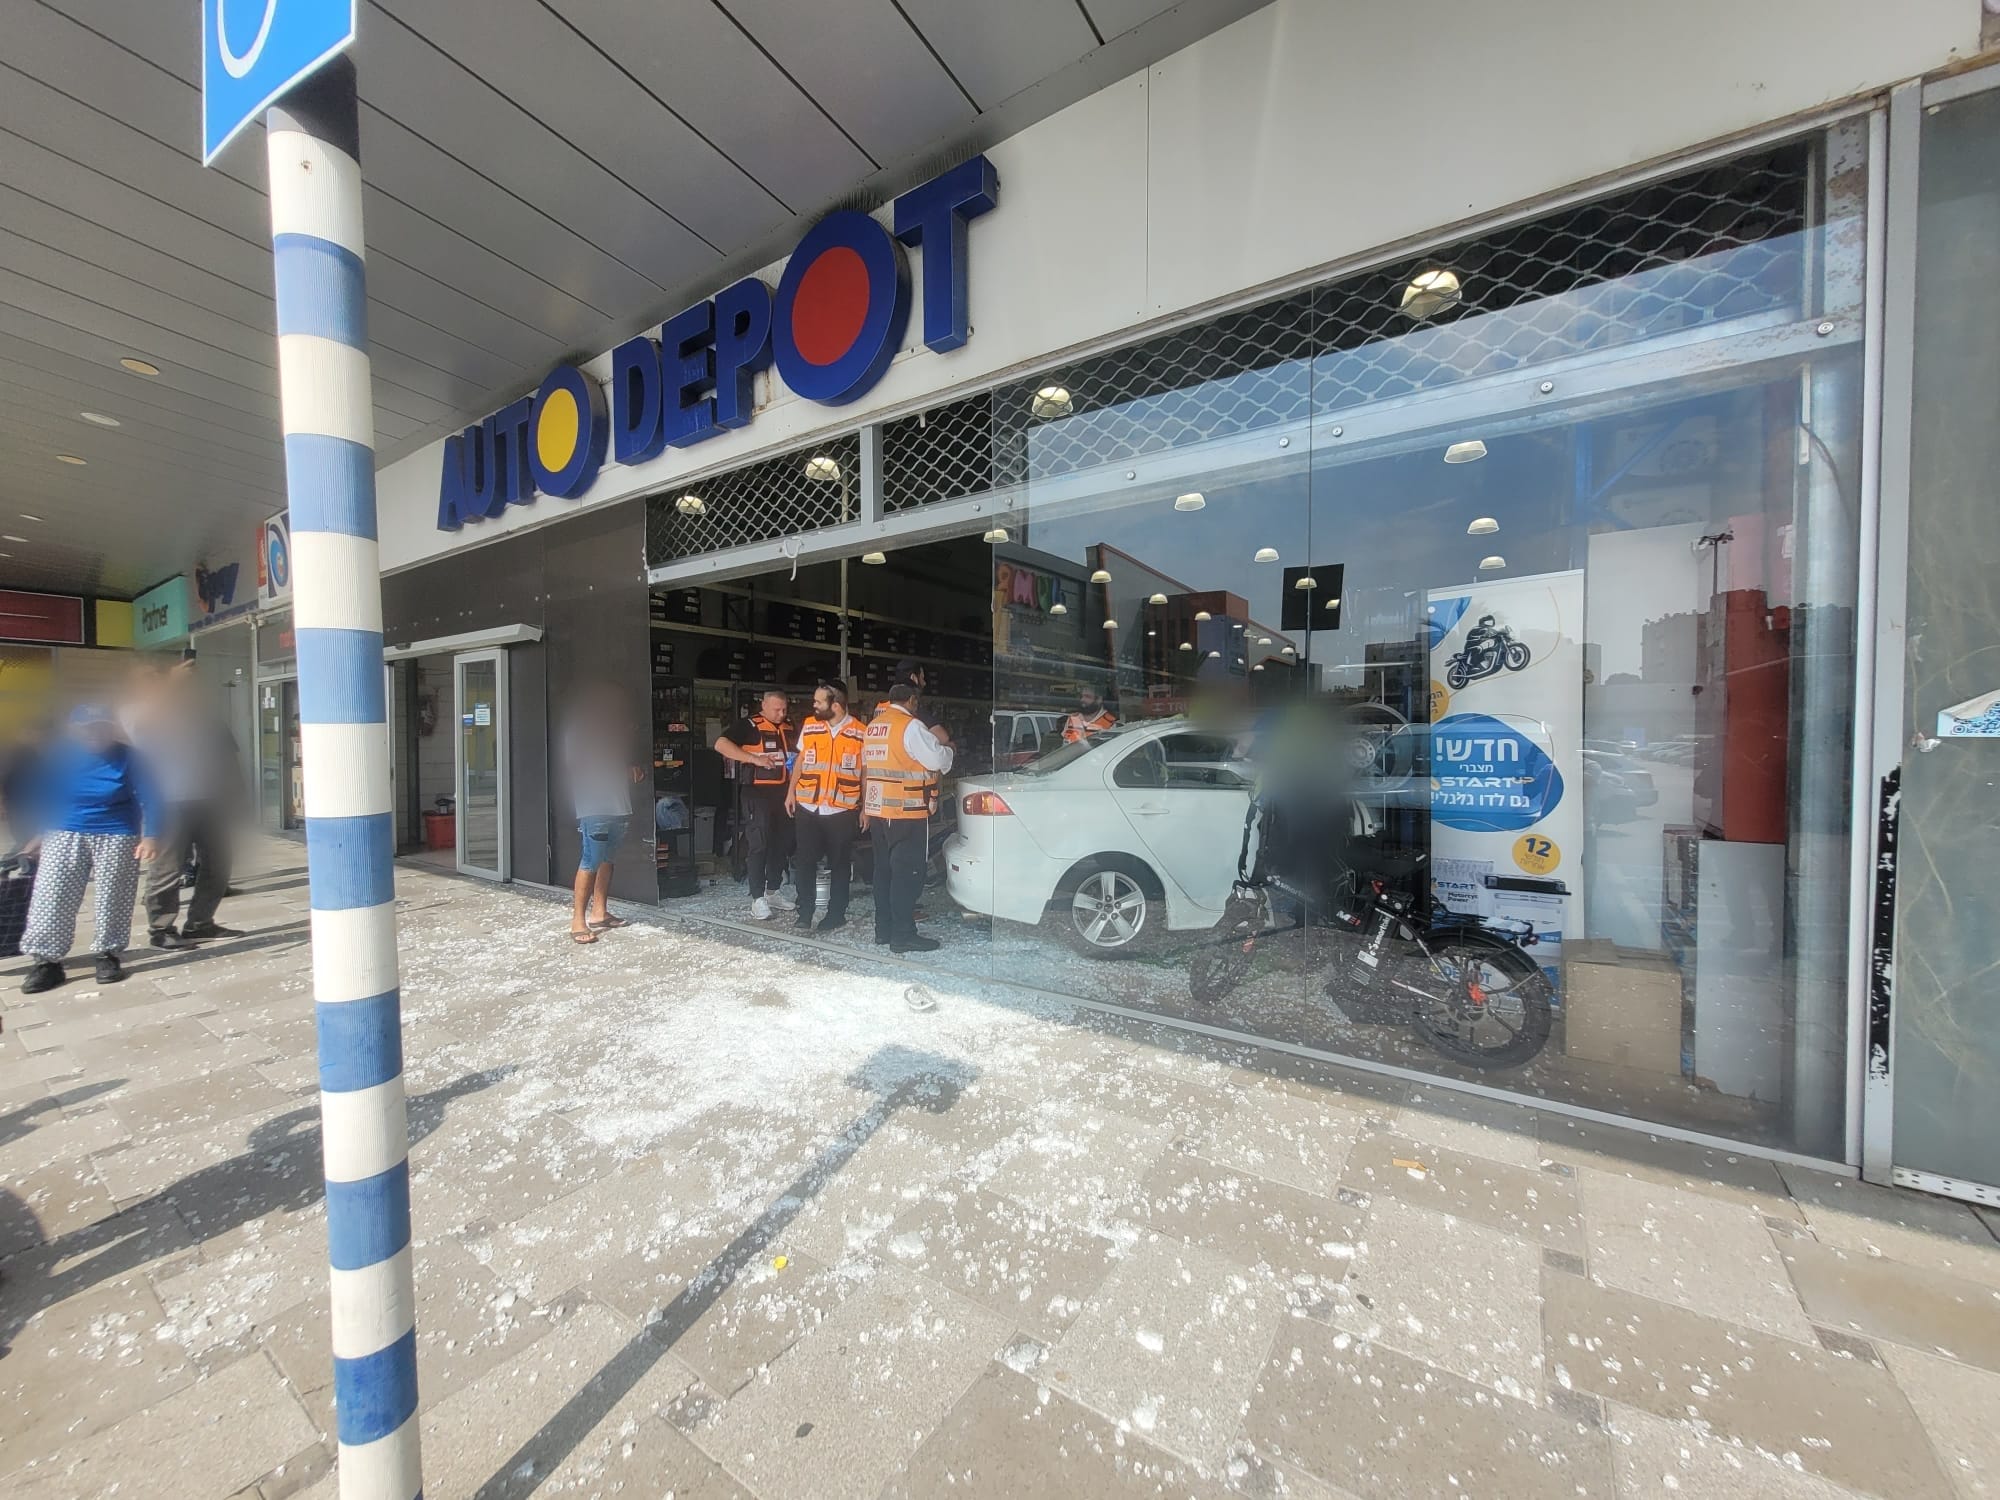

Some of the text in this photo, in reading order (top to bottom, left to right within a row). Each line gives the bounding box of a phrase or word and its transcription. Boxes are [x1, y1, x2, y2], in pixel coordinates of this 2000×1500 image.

[437, 154, 999, 531] AUTO DEPOT
[867, 726, 888, 737] חובש
[1436, 737, 1519, 762] חדש!
[1459, 764, 1494, 773] מצברי
[1479, 793, 1505, 806] לדו
[1510, 796, 1530, 808] גם
[1526, 838, 1552, 858] 12
